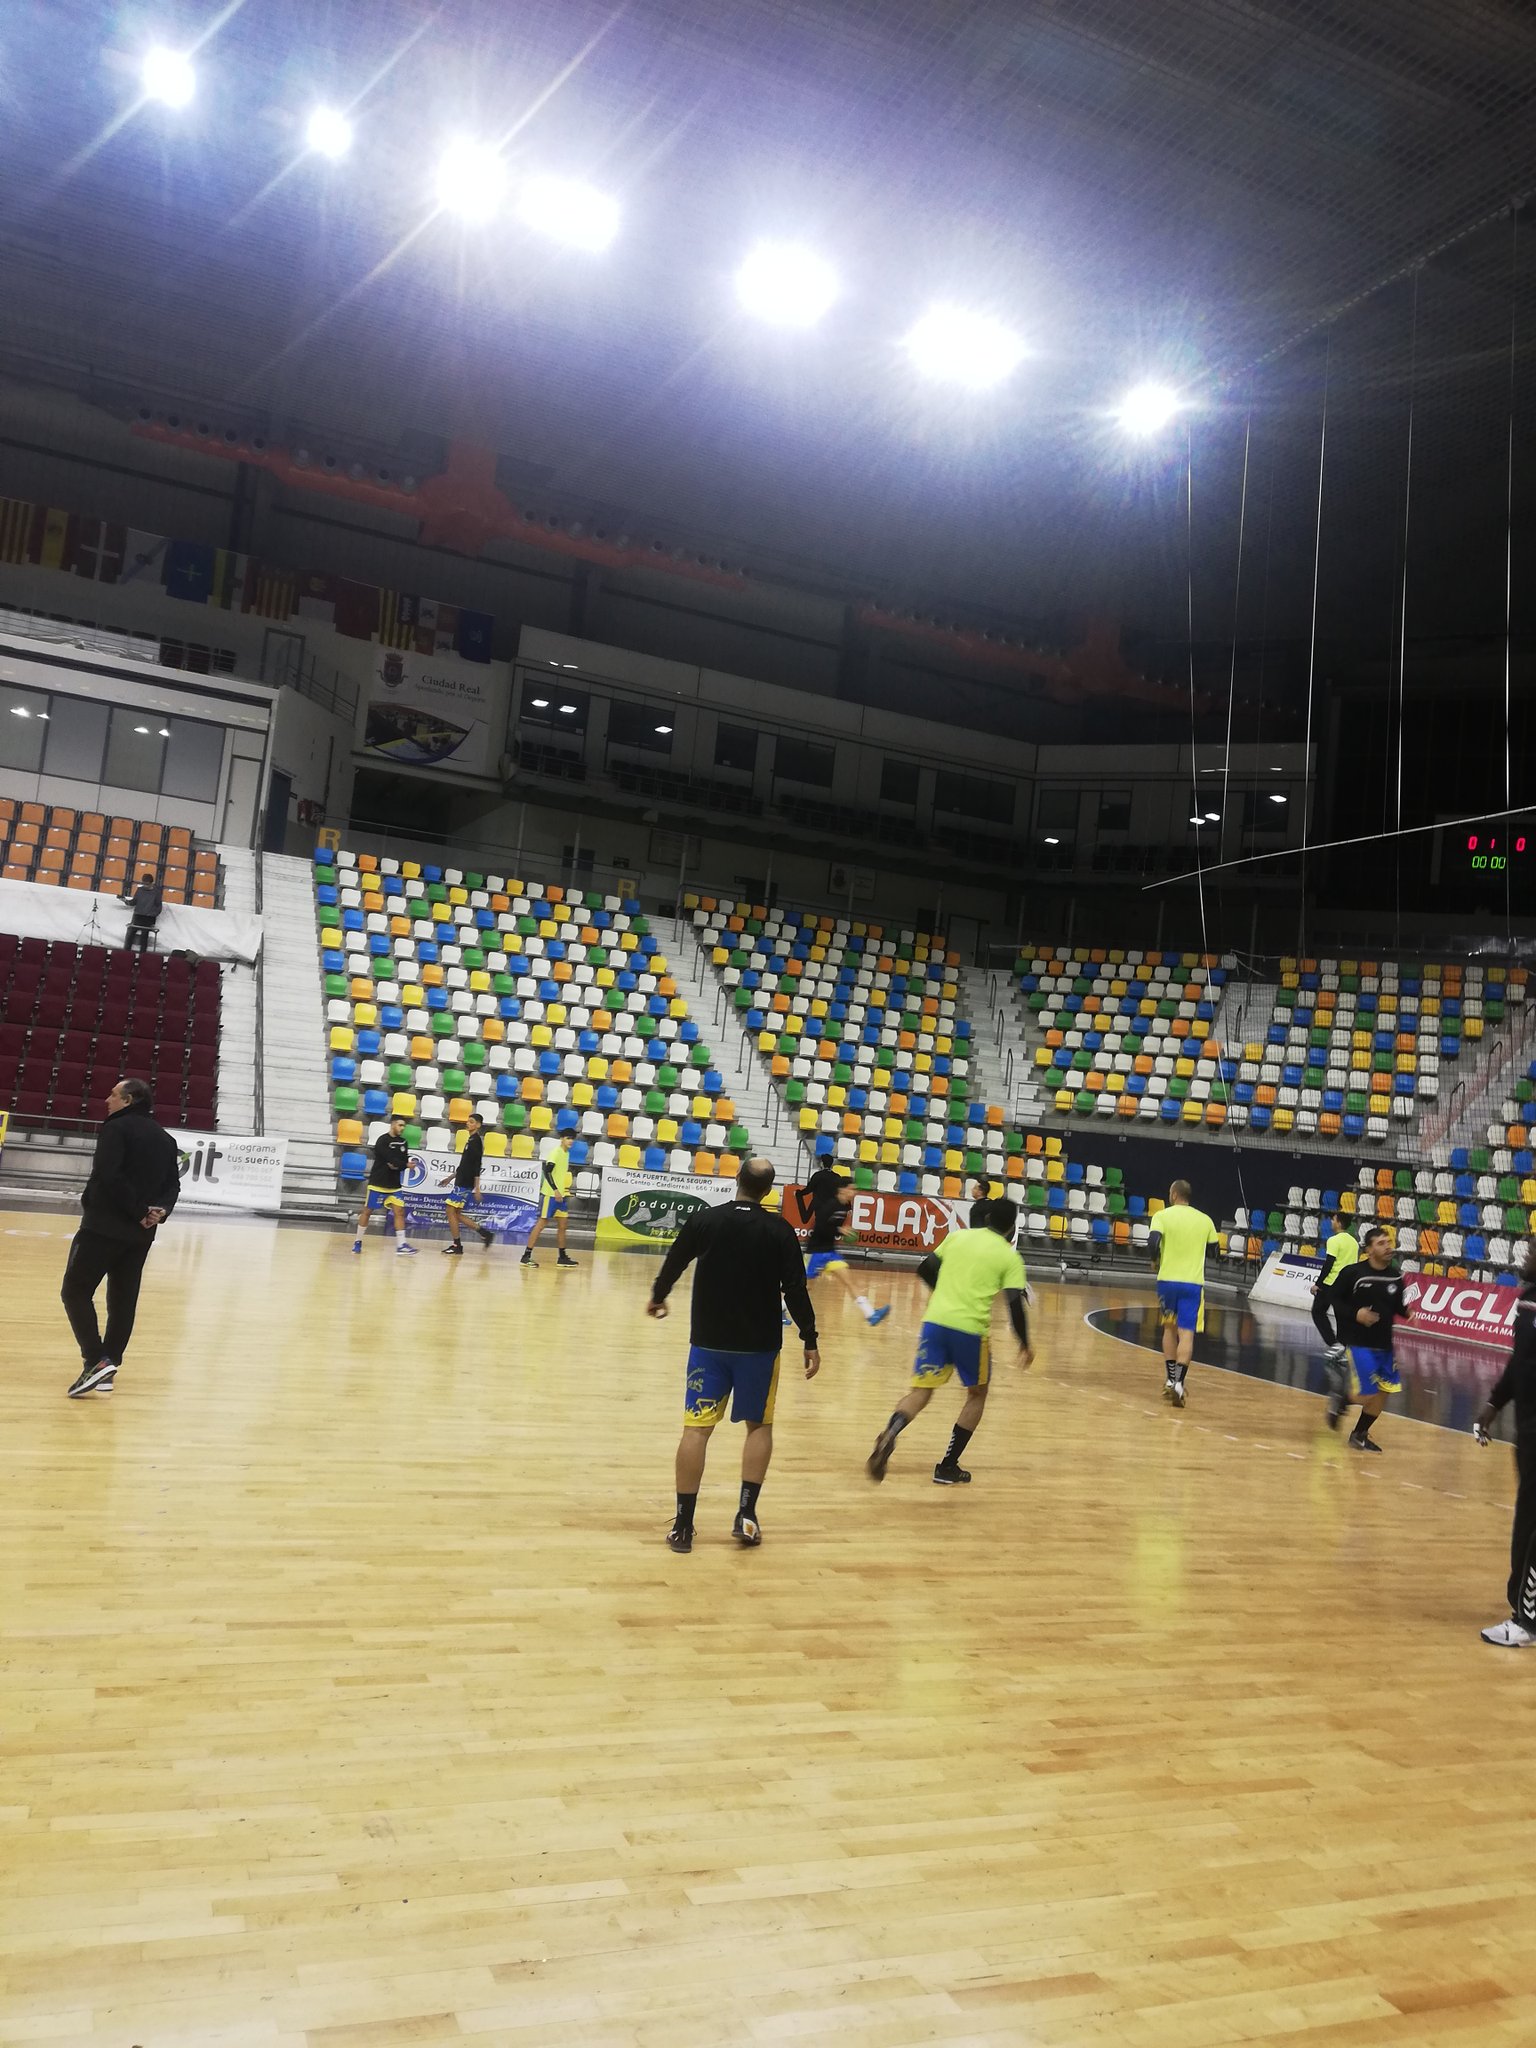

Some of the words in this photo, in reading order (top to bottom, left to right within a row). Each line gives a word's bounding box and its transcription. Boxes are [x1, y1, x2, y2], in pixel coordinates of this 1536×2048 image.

[422, 675, 456, 690] Ciudad
[459, 683, 480, 695] Real
[318, 827, 341, 851] R
[1468, 836, 1477, 849] 0
[1491, 838, 1495, 848] 1
[1516, 838, 1525, 851] 0
[229, 1142, 277, 1154] Programa
[227, 1154, 243, 1164] tus
[244, 1155, 281, 1166] sueños
[491, 1165, 539, 1180] Palacio
[626, 1171, 641, 1179] PISA
[643, 1173, 669, 1182] FUERTE,
[488, 1183, 535, 1195] JURÍDICO
[607, 1176, 629, 1184] Clínica
[630, 1179, 650, 1187] Centro
[656, 1181, 691, 1190] Cardiorreal
[404, 1202, 443, 1210] ncapacidades
[478, 1202, 508, 1210] Accidentes
[620, 1194, 710, 1219] Podologí
[858, 1232, 890, 1245] iudad
[893, 1235, 918, 1247] Real
[1437, 1315, 1448, 1324] DE
